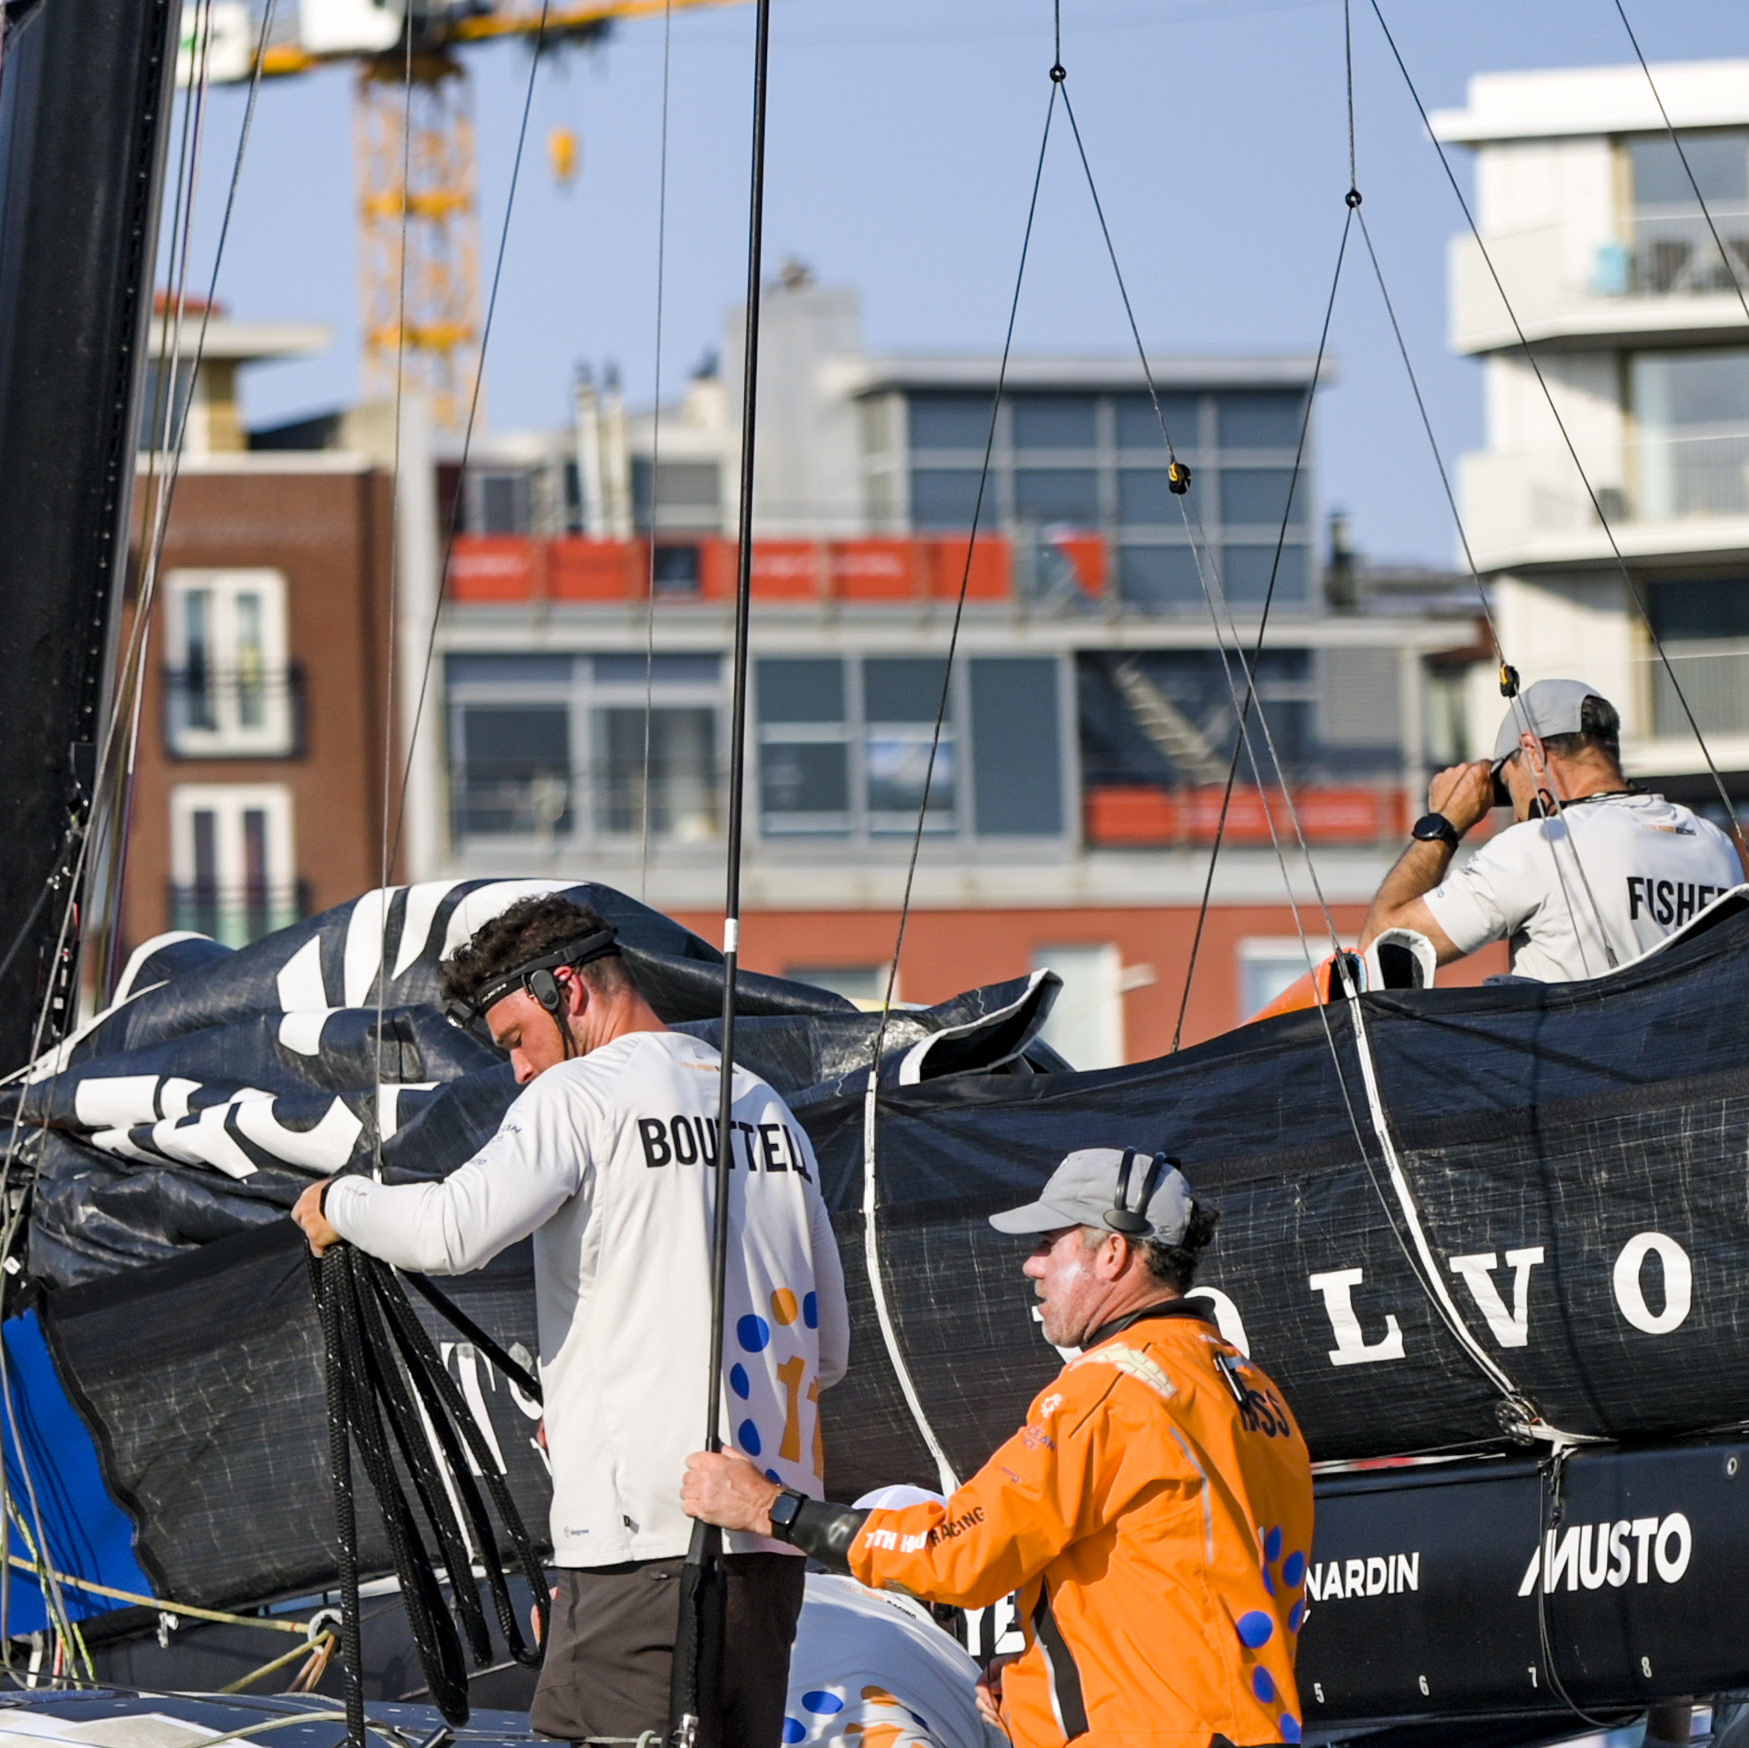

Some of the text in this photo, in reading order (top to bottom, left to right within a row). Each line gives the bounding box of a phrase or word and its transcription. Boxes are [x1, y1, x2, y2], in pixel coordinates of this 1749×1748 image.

[1627, 876, 1729, 927] FISHE
[1032, 1230, 1693, 1366] OLVO
[929, 1506, 985, 1548] RACING
[1518, 1512, 1693, 1597] MUSTO
[1305, 1551, 1420, 1602] NARDIN
[1418, 1674, 1430, 1697] 6
[1527, 1666, 1538, 1688] 7
[1641, 1656, 1653, 1679] 8
[1313, 1682, 1325, 1704] 5
